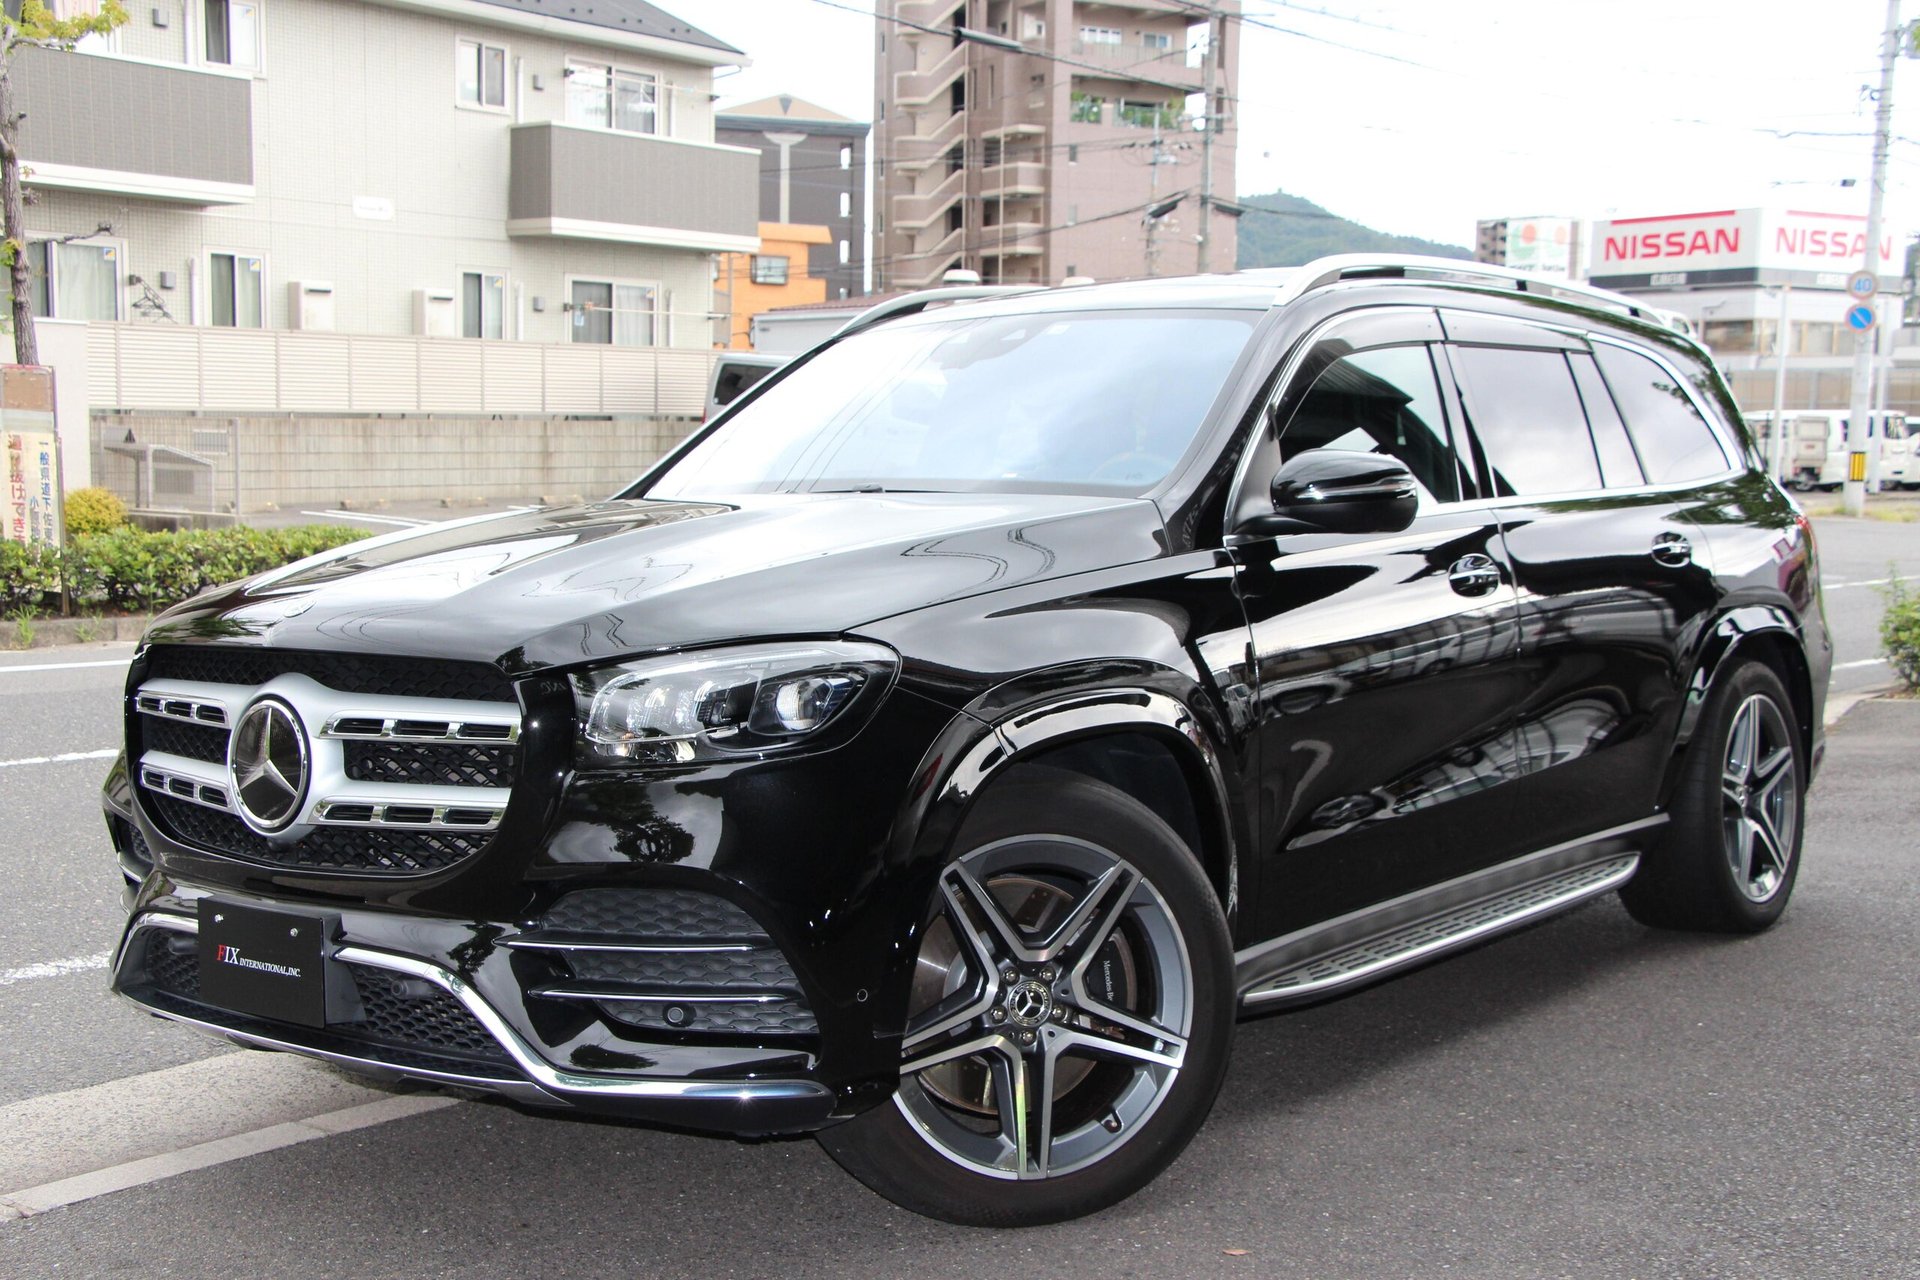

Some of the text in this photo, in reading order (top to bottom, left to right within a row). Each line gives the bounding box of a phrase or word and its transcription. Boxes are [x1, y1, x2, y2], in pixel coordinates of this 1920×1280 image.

[1604, 227, 1740, 261] NISSAN
[1776, 226, 1892, 261] NISSAN
[1854, 277, 1872, 293] 40
[216, 944, 240, 965] FIX
